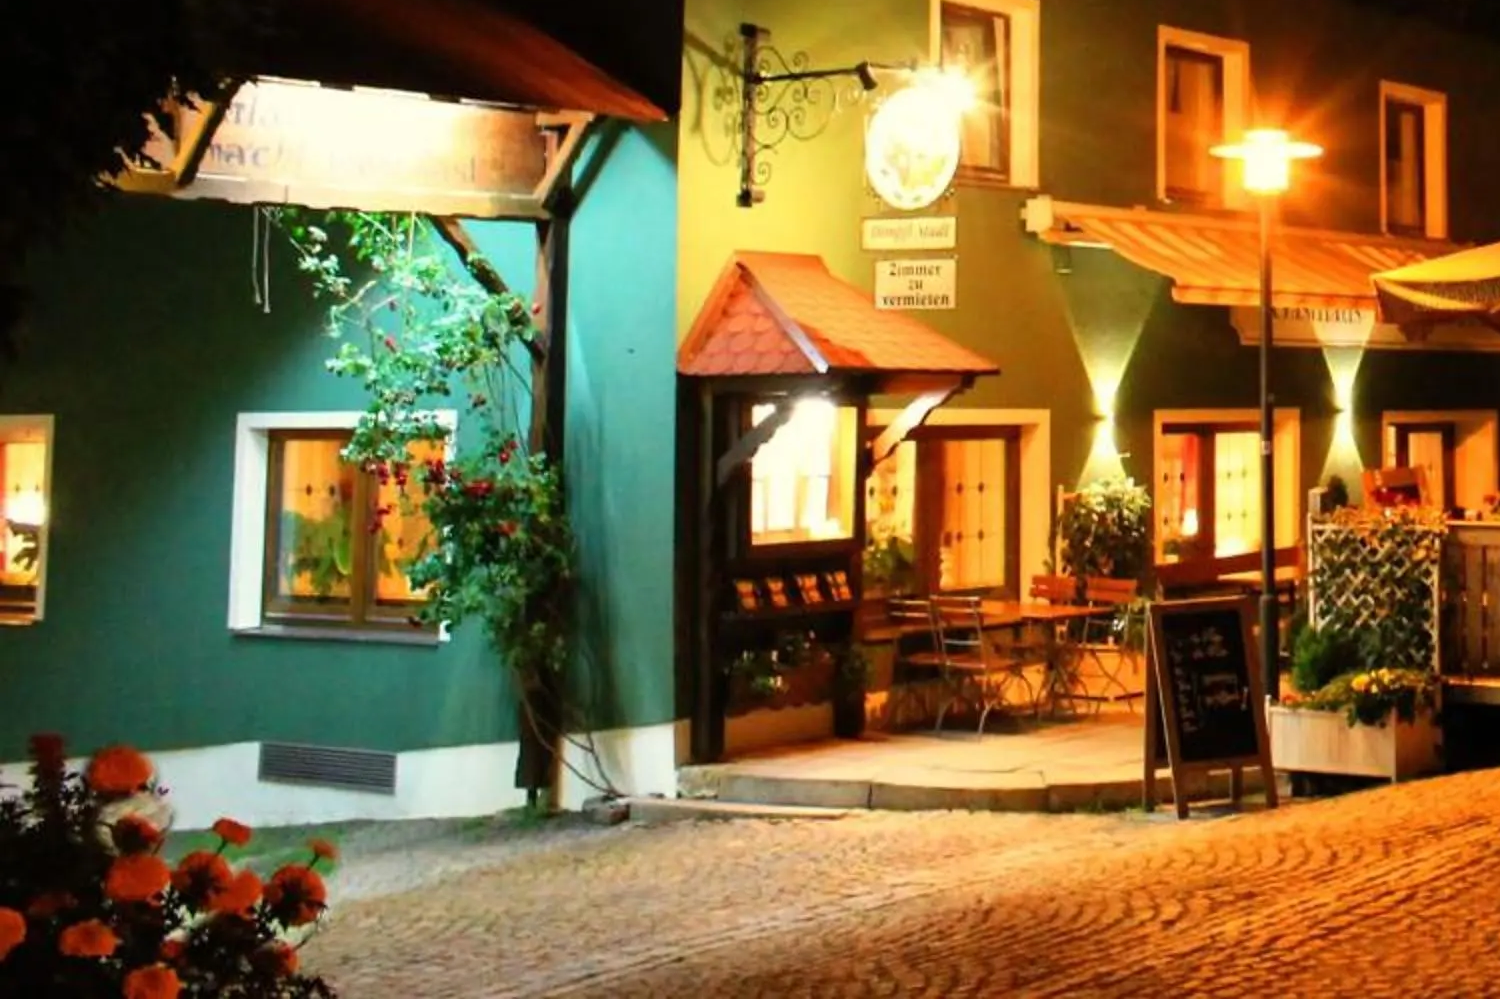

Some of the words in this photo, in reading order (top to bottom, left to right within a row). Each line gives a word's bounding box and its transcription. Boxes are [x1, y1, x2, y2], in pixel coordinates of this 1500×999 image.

[889, 262, 942, 277] Zimmer
[908, 279, 923, 291] zu
[882, 292, 950, 306] vermieten
